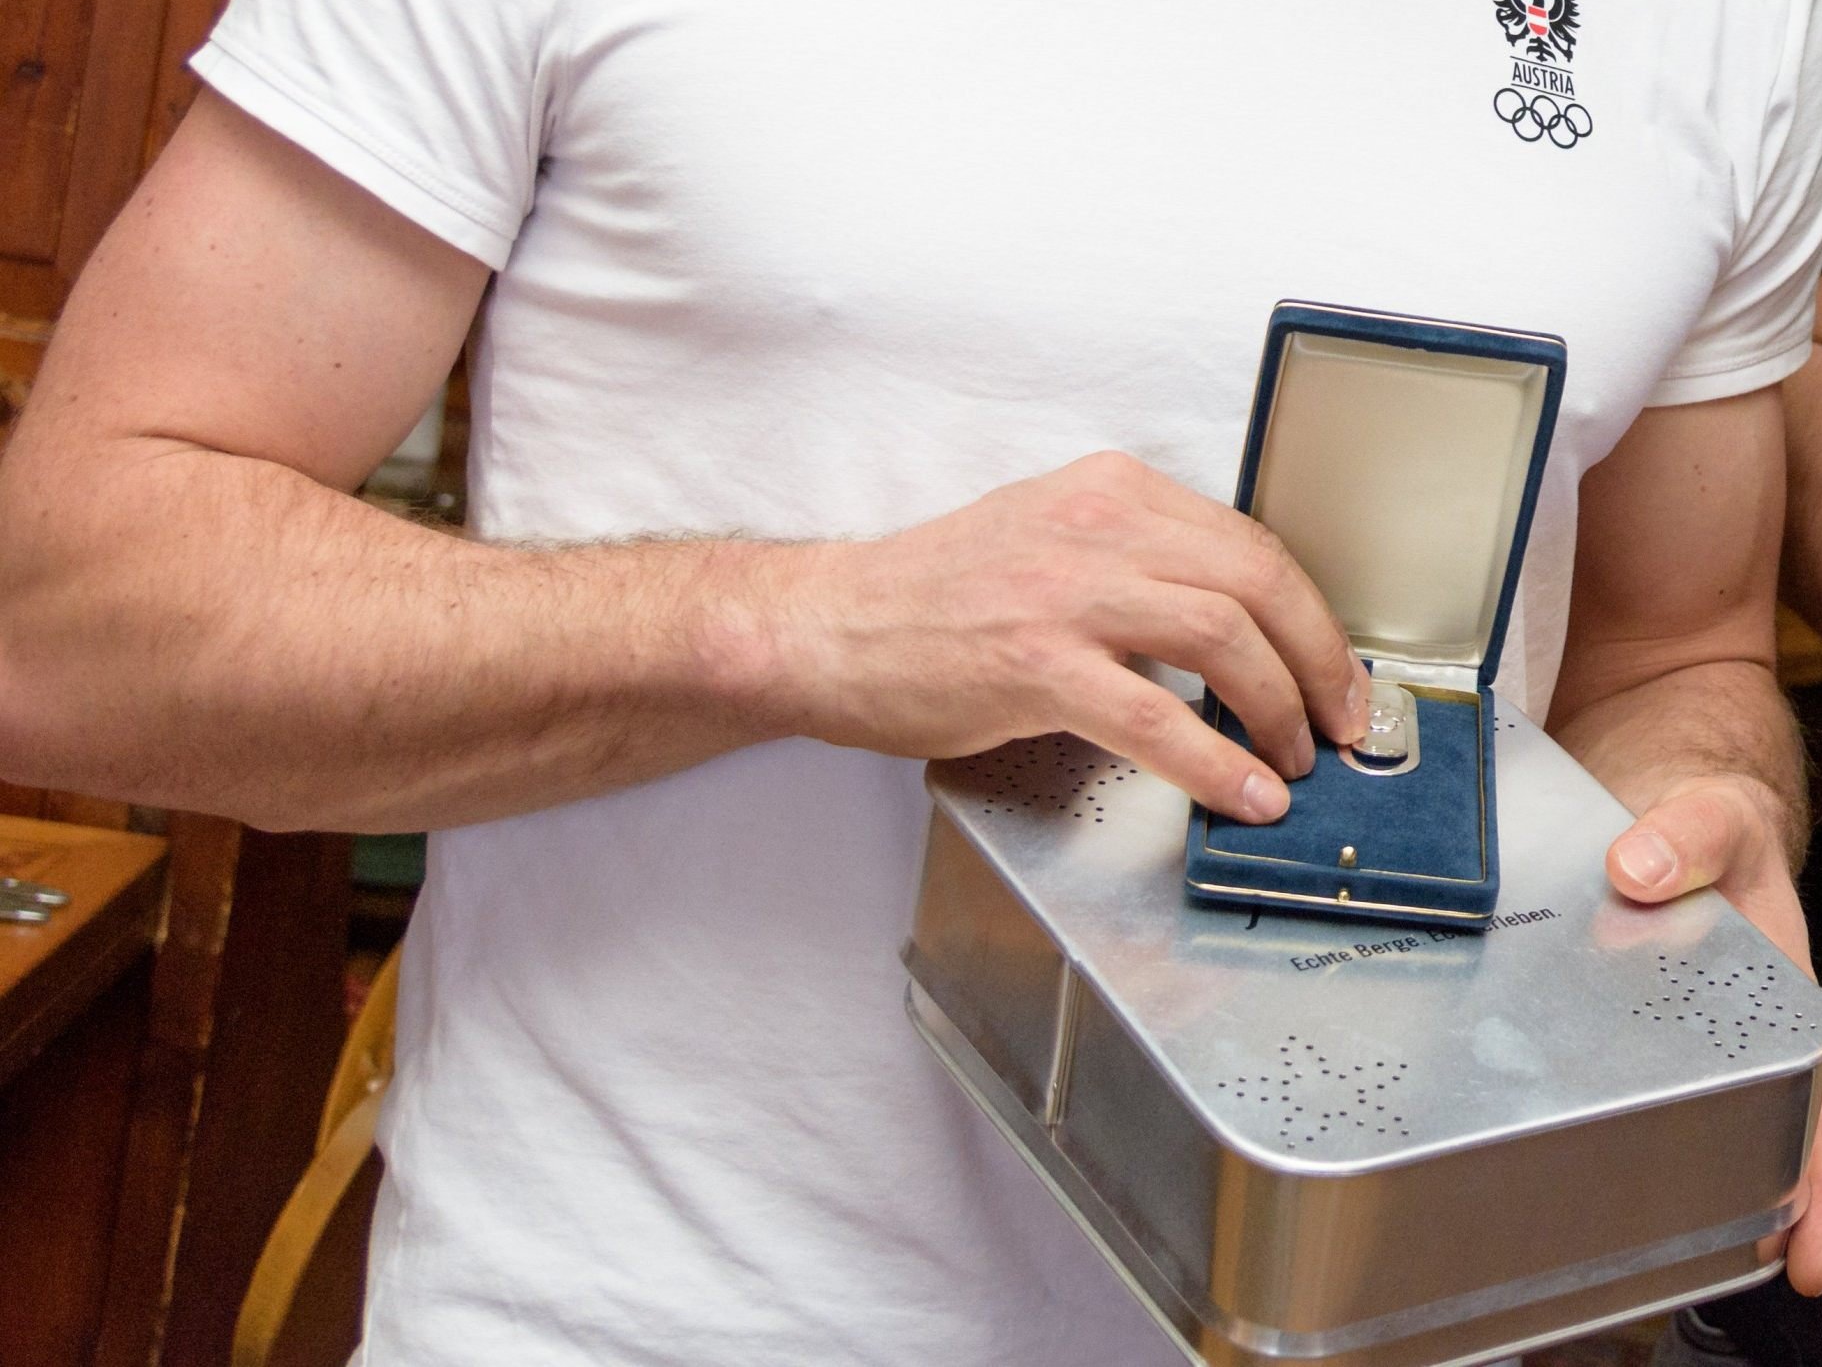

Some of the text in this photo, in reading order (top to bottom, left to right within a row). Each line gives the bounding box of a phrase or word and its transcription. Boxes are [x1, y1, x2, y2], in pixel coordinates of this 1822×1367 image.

[1512, 62, 1575, 96] AUSTRIA
[1290, 951, 1353, 972] Echte
[1353, 935, 1427, 958] Berge.
